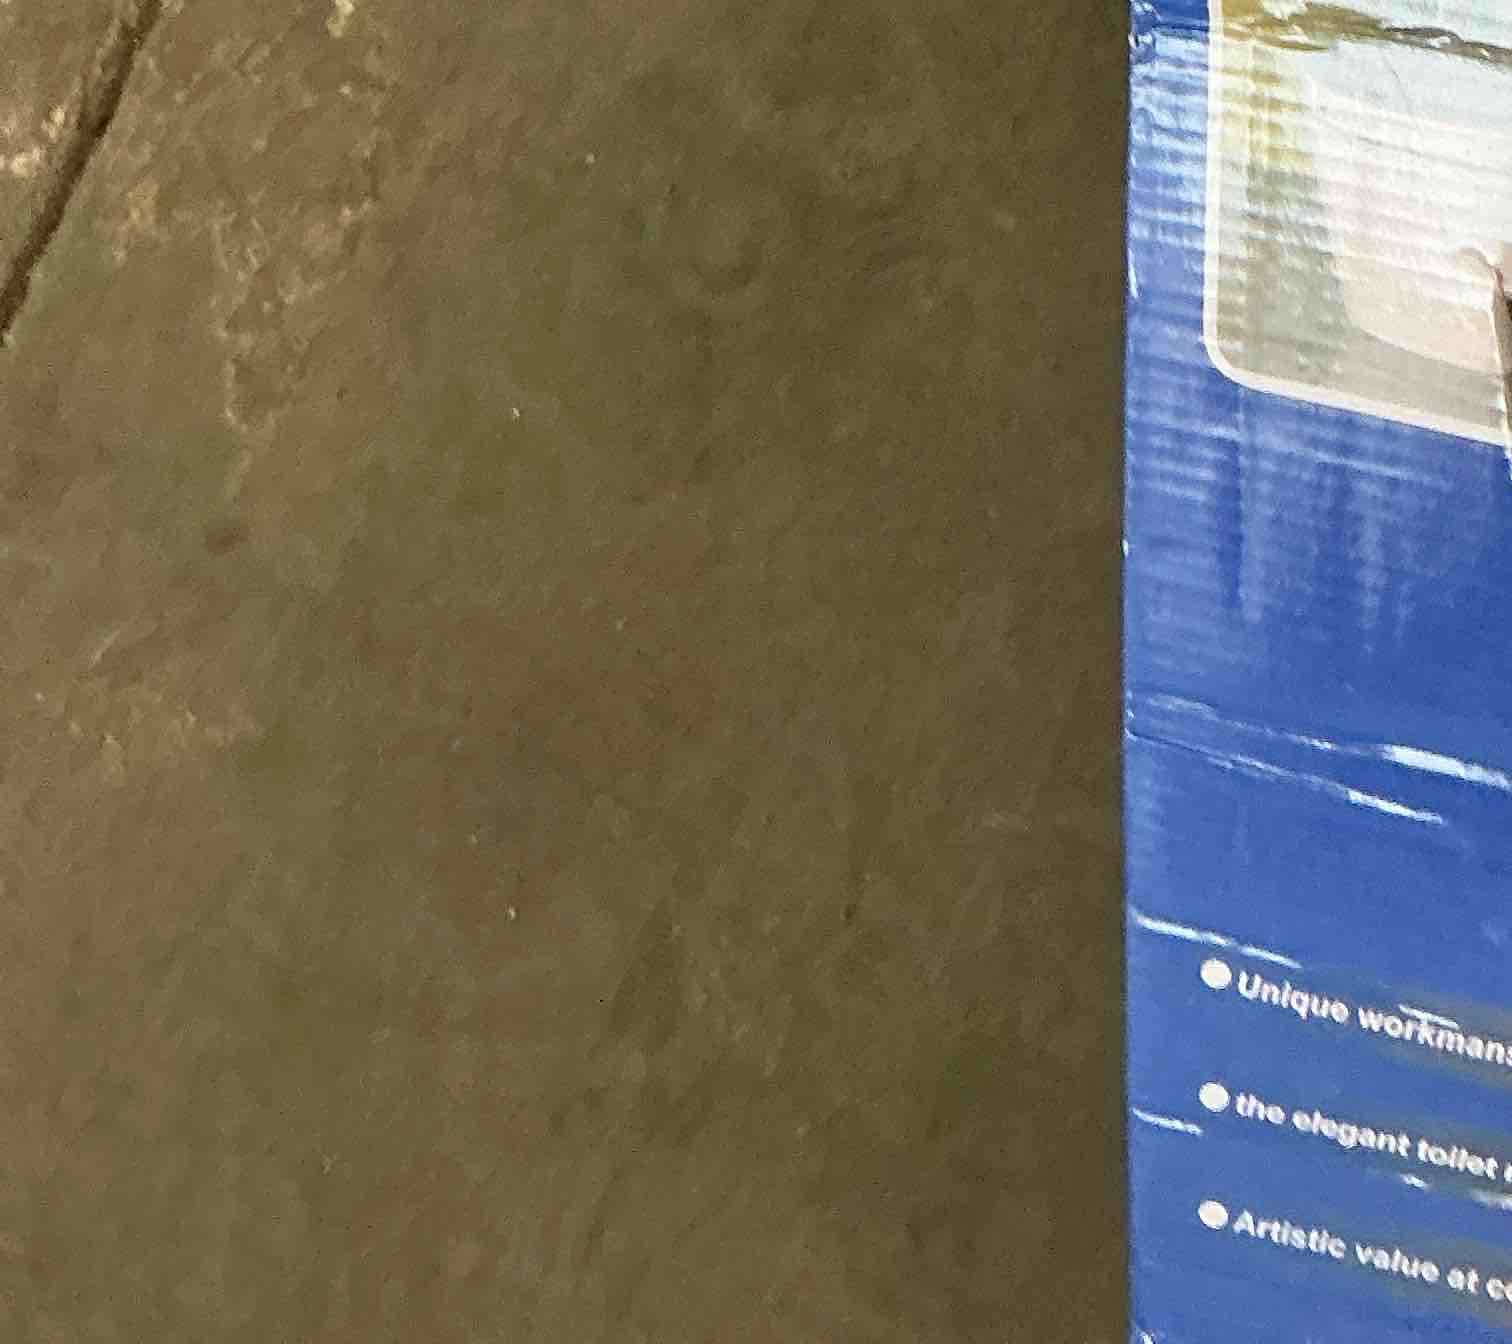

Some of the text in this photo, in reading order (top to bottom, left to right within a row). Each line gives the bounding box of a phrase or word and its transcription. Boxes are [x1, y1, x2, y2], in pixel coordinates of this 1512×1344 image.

[1238, 970, 1349, 1023] Unique
[1236, 1092, 1285, 1125] the
[1292, 1108, 1411, 1159] elegant
[1417, 1138, 1500, 1181] toilet
[1232, 1209, 1347, 1259] Artistic
[1355, 1241, 1441, 1284] value
[1447, 1264, 1480, 1294] at
